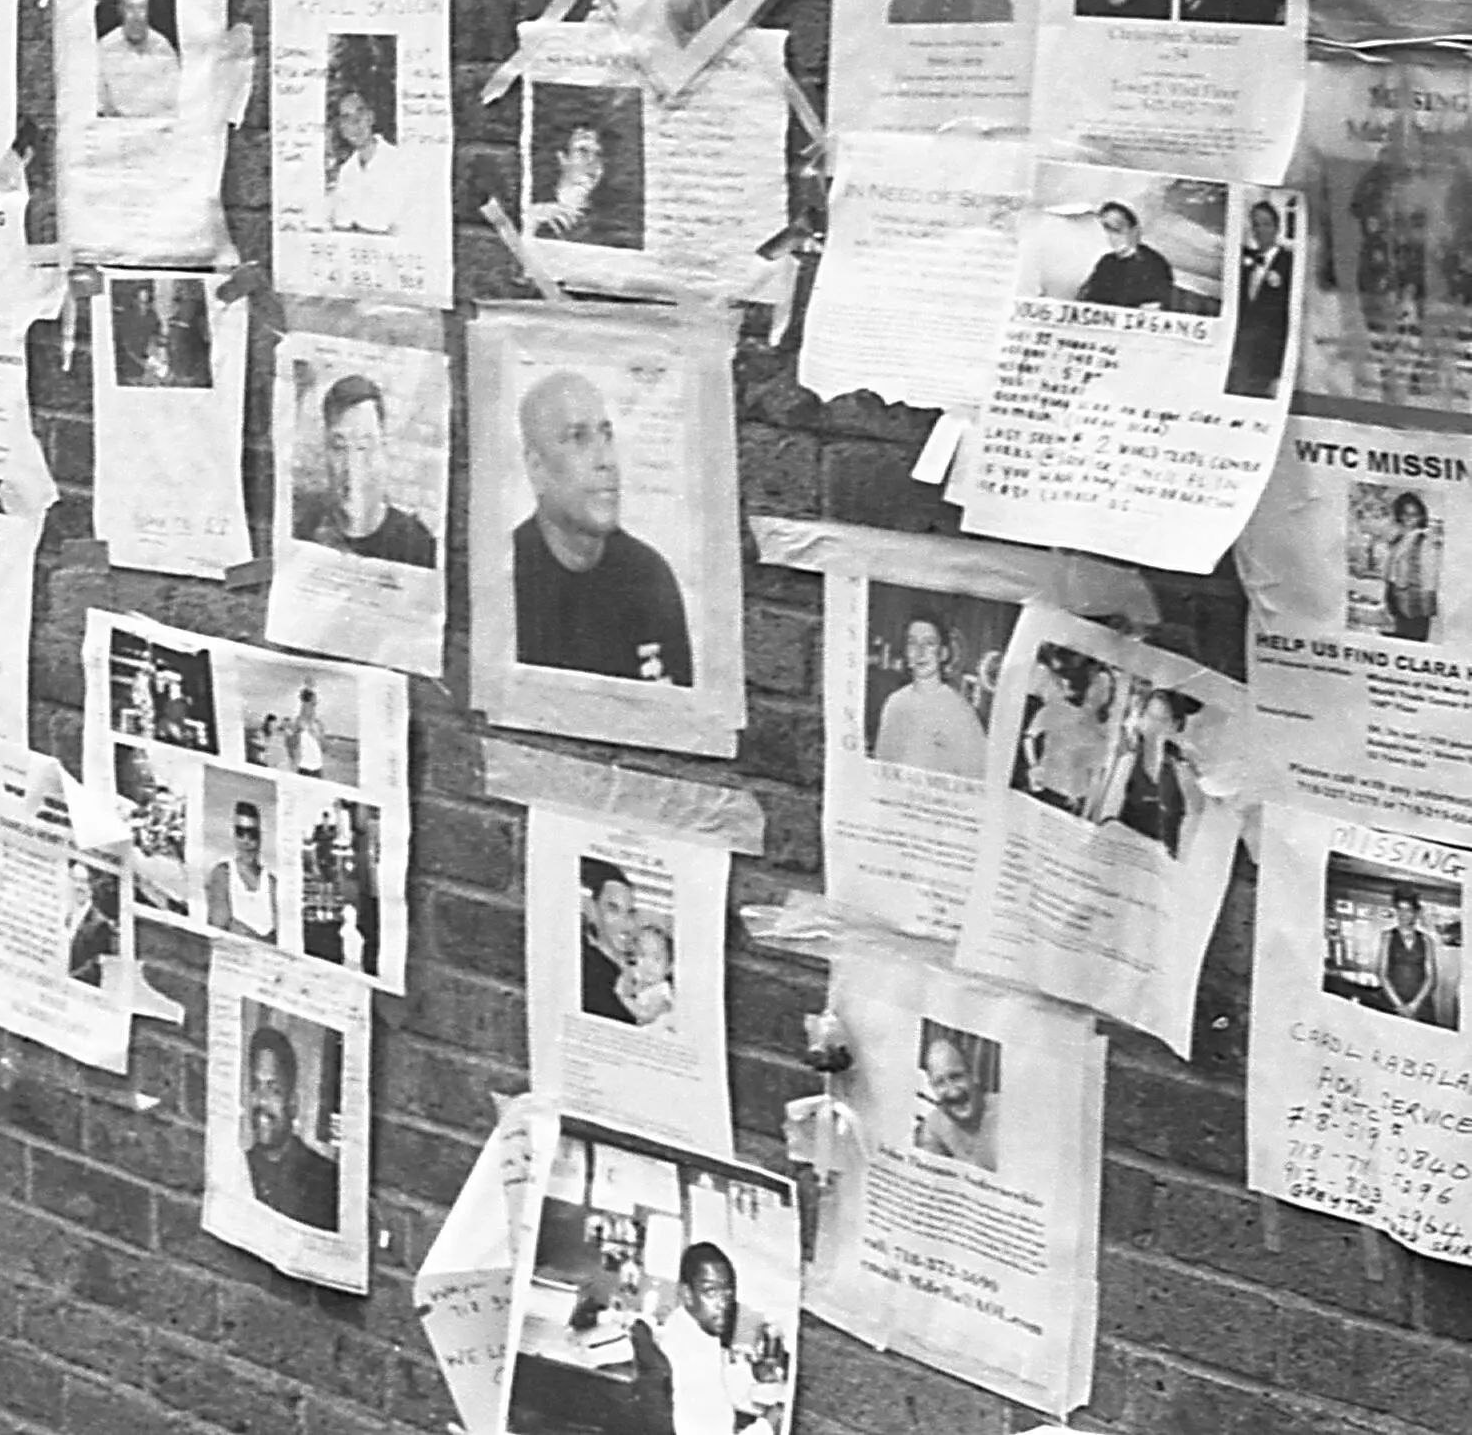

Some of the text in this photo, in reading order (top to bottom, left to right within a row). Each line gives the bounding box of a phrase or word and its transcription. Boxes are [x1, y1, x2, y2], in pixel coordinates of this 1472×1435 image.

[1059, 302, 1118, 327] JASON
[1296, 439, 1359, 469] WTC
[1256, 632, 1462, 680] HELP US FIND CLARA
[1332, 826, 1467, 878] MISSING
